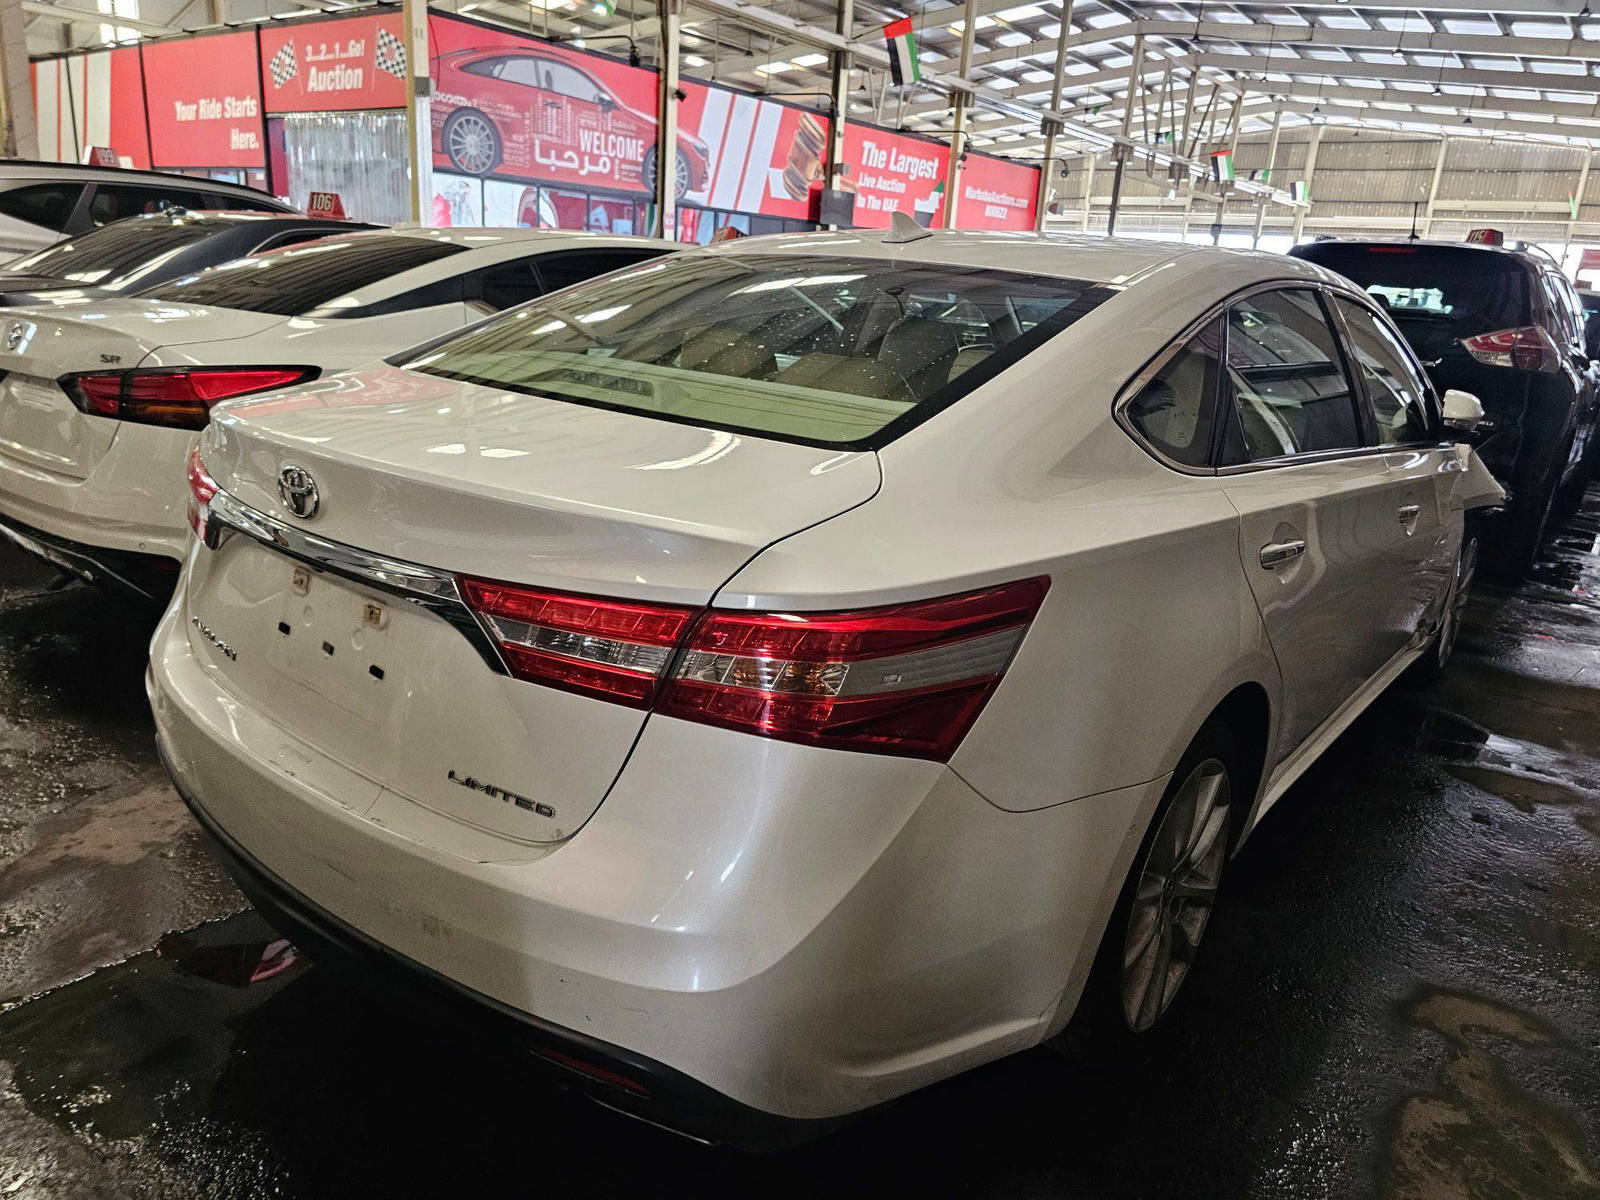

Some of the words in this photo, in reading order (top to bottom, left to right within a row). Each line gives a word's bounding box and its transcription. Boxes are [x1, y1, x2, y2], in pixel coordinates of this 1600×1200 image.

[307, 64, 363, 92] Auction
[175, 101, 197, 121] Your
[199, 98, 222, 120] Ride
[224, 96, 257, 118] Starts
[231, 128, 259, 150] Here.
[580, 129, 644, 162] WELCOME
[534, 138, 611, 176] مرحبا
[862, 141, 886, 169] The
[888, 147, 939, 180] Largest
[859, 172, 876, 188] Live
[876, 176, 906, 194] Auction
[312, 193, 332, 210] 106
[867, 195, 881, 210] The
[882, 198, 899, 212] UAE
[100, 353, 121, 364] SR
[448, 769, 556, 819] LIMITED
